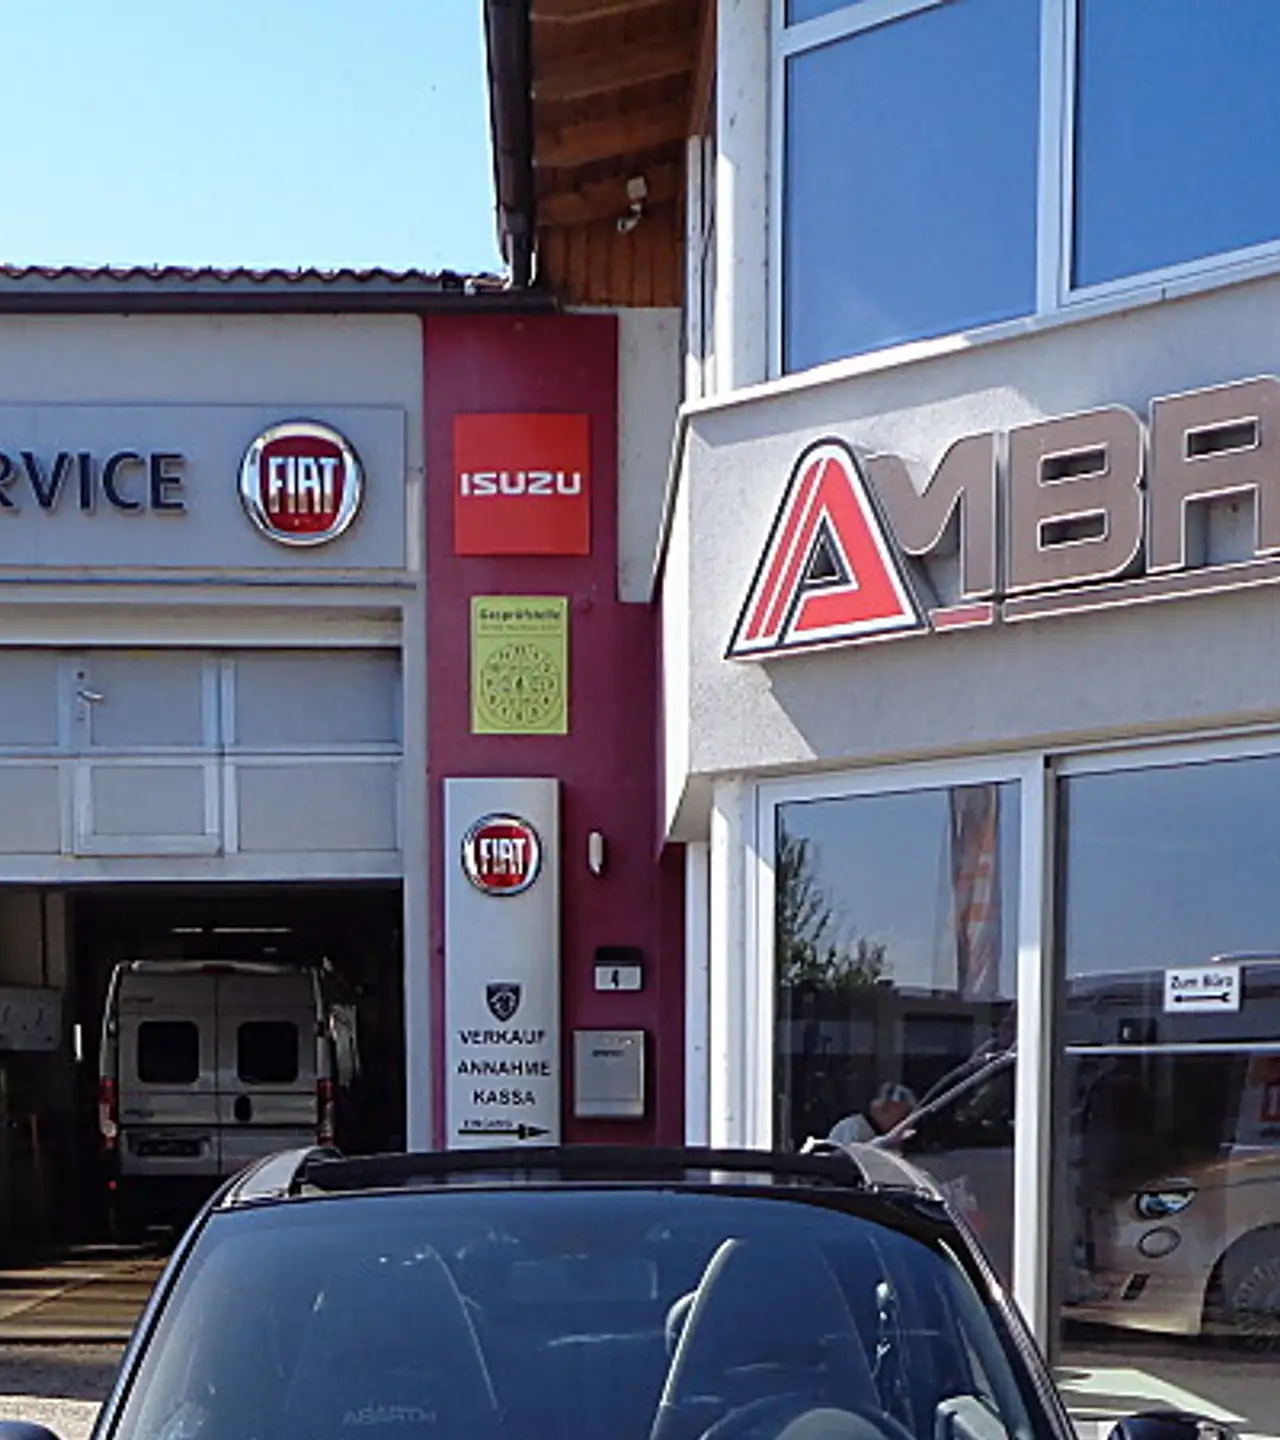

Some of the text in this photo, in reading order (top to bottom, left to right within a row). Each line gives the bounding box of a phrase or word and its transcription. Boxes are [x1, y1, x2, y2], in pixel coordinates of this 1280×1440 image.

[267, 457, 339, 513] FIAT
[460, 471, 581, 495] ISUZU
[479, 838, 526, 875] FIAT
[458, 1030, 545, 1045] VERKAUF
[457, 1060, 551, 1076] ANNAHME
[473, 1088, 535, 1105] KASSA
